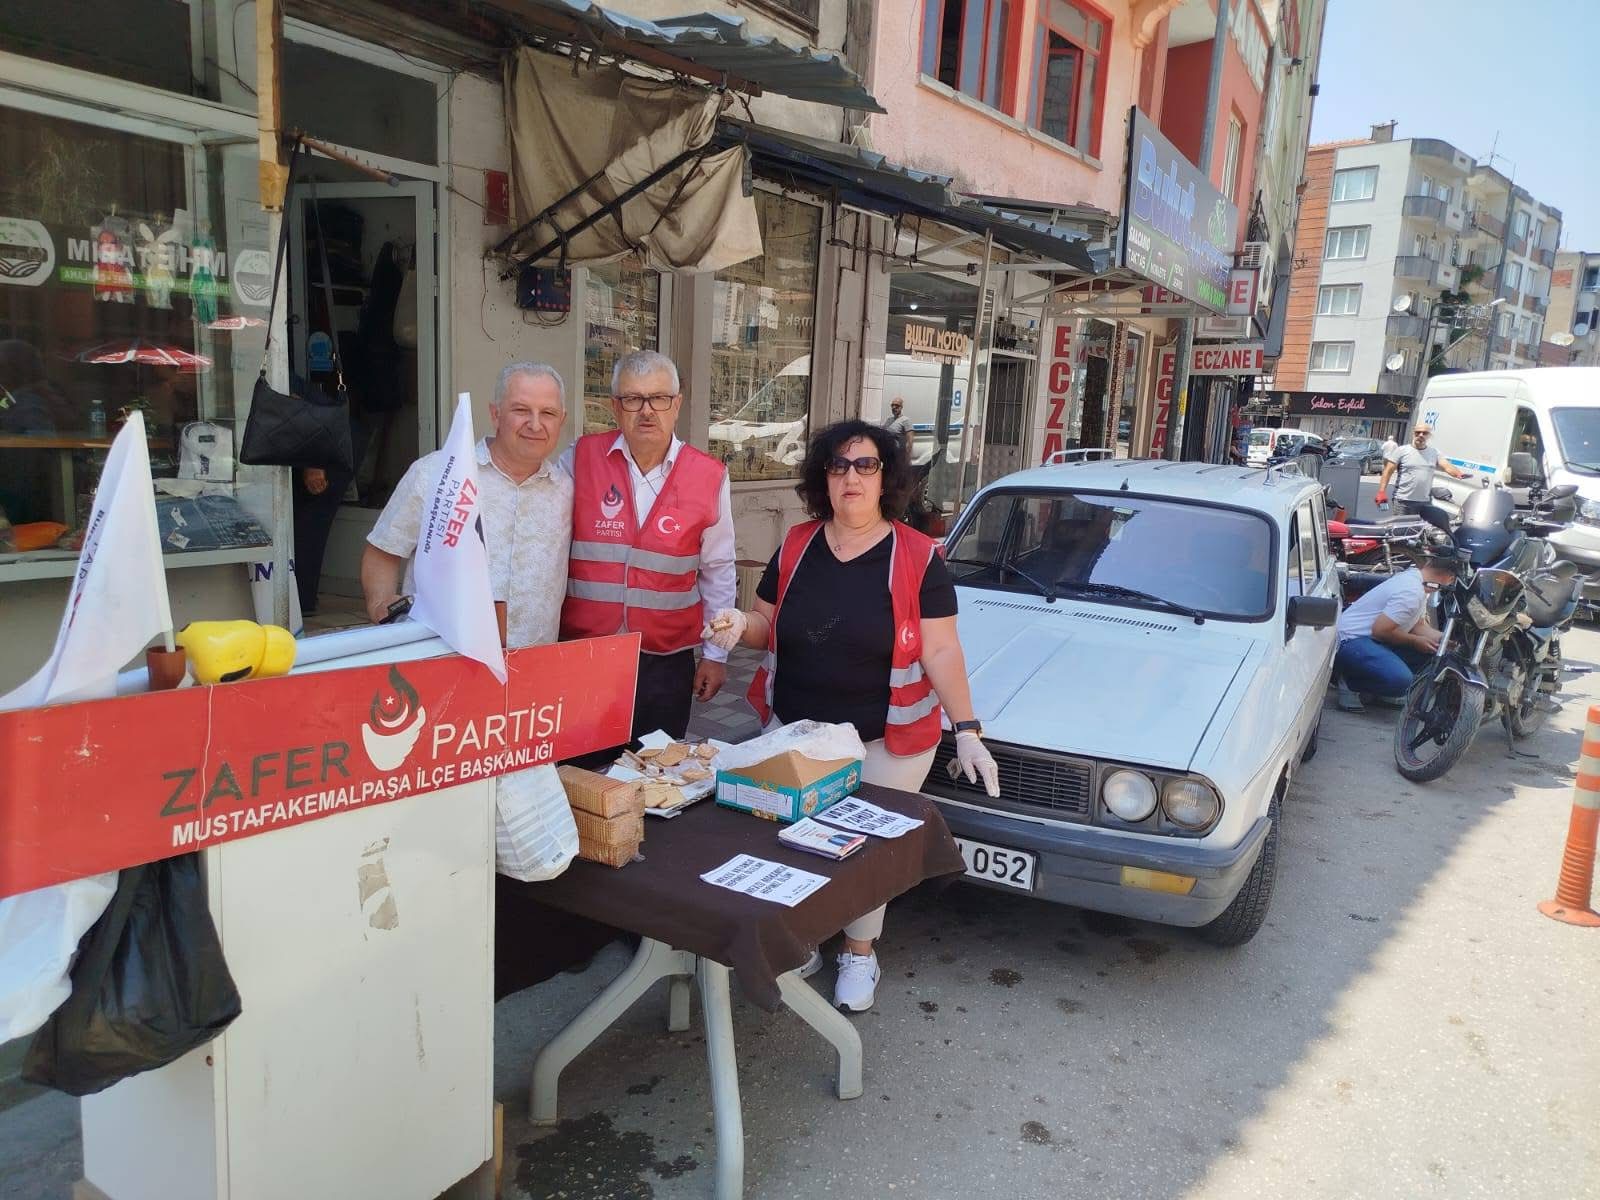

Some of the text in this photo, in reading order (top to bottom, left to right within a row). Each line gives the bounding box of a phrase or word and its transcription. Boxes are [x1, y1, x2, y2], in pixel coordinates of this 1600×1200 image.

[905, 324, 935, 350] BULUT
[1194, 350, 1252, 370] ECZANE
[1311, 395, 1336, 410] Salon
[439, 456, 455, 486] BURSA
[443, 478, 478, 547] ZAFER
[595, 520, 624, 529] ZAFER
[160, 697, 564, 818] ZAFER PARTİSİ
[172, 738, 553, 848] MUSTAFAKEMALPAŞA İLÇE BAŞKANLIĞI
[973, 847, 1027, 884] 052
